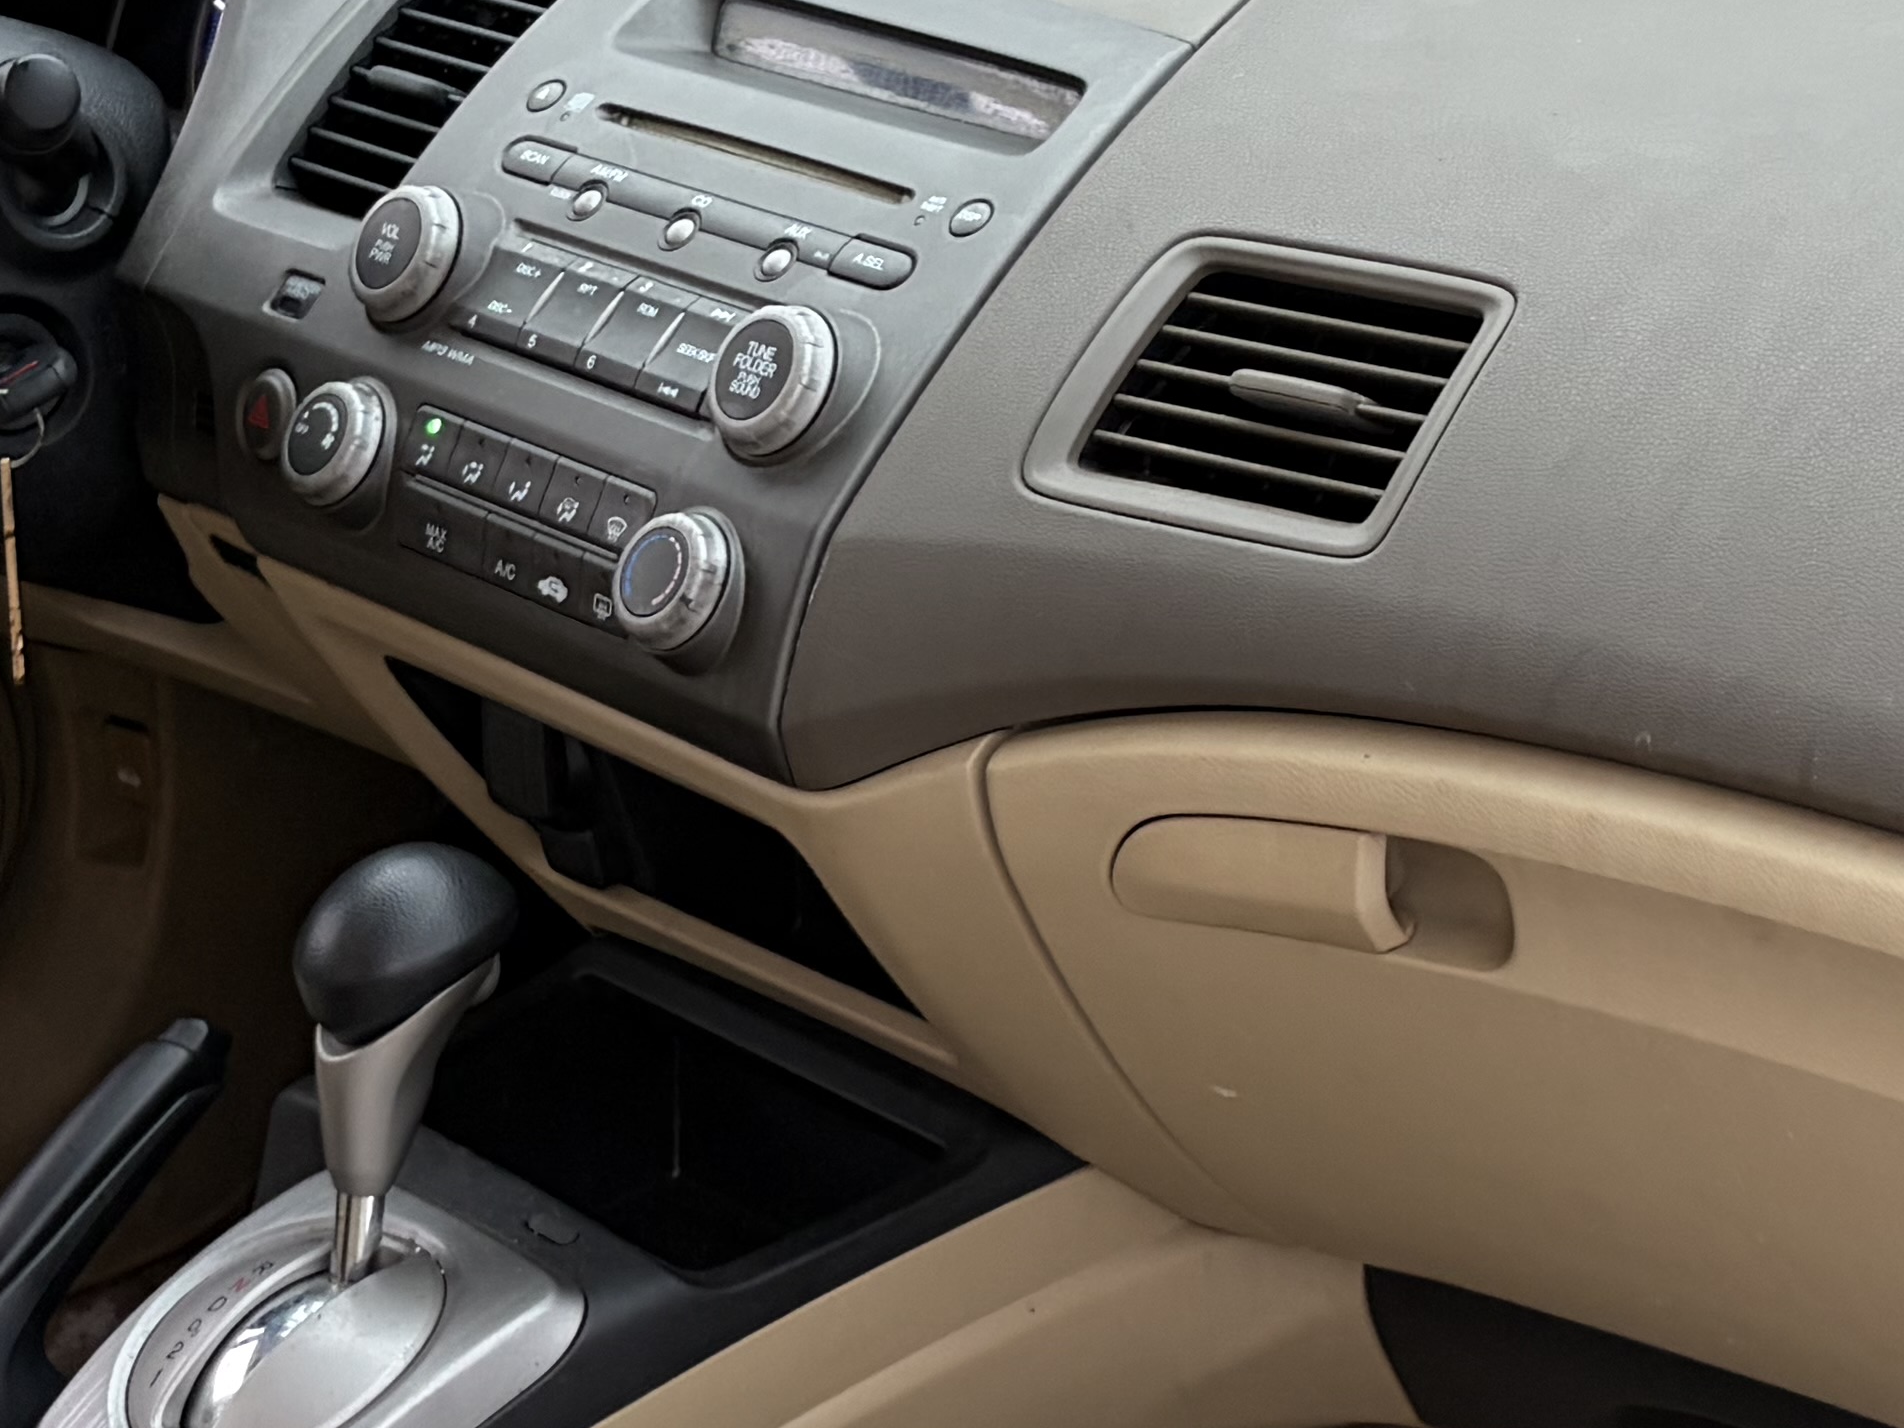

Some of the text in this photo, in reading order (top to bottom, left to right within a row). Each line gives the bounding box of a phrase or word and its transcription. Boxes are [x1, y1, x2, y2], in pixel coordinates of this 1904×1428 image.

[520, 149, 551, 165] SCAN
[381, 221, 400, 240] VOL
[368, 247, 393, 265] PWR
[421, 340, 449, 356] MP3
[527, 334, 538, 349] 5
[747, 340, 777, 362] TUNE
[586, 355, 598, 370] 6
[733, 352, 778, 379] FOLDER
[728, 379, 761, 399] SOUND
[425, 522, 447, 541] MAX
[494, 559, 516, 581] A/C
[166, 1340, 185, 1360] 2
